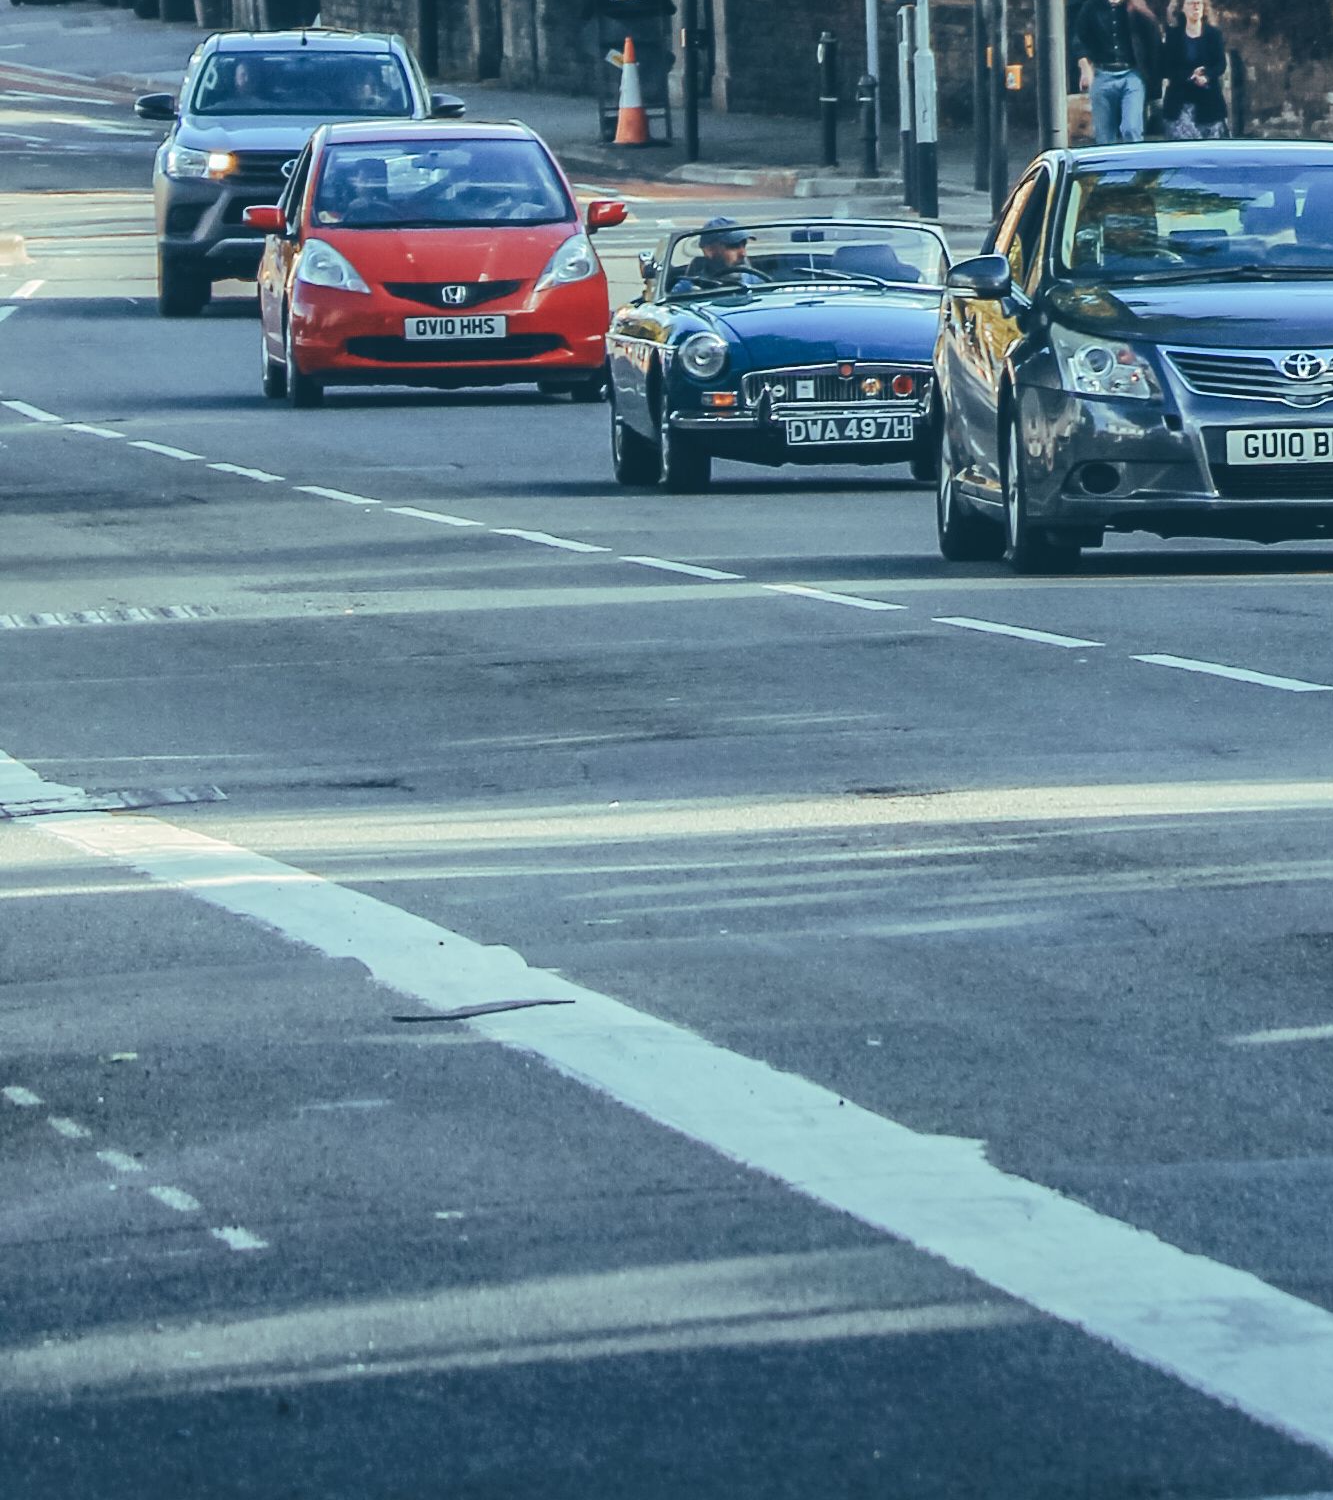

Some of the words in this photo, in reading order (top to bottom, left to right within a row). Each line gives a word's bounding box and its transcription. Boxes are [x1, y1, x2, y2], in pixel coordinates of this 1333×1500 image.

[416, 318, 455, 336] OV10
[460, 318, 495, 335] HHS
[790, 419, 839, 442] DWA
[844, 417, 909, 439] 497H
[1244, 432, 1304, 458] GU10
